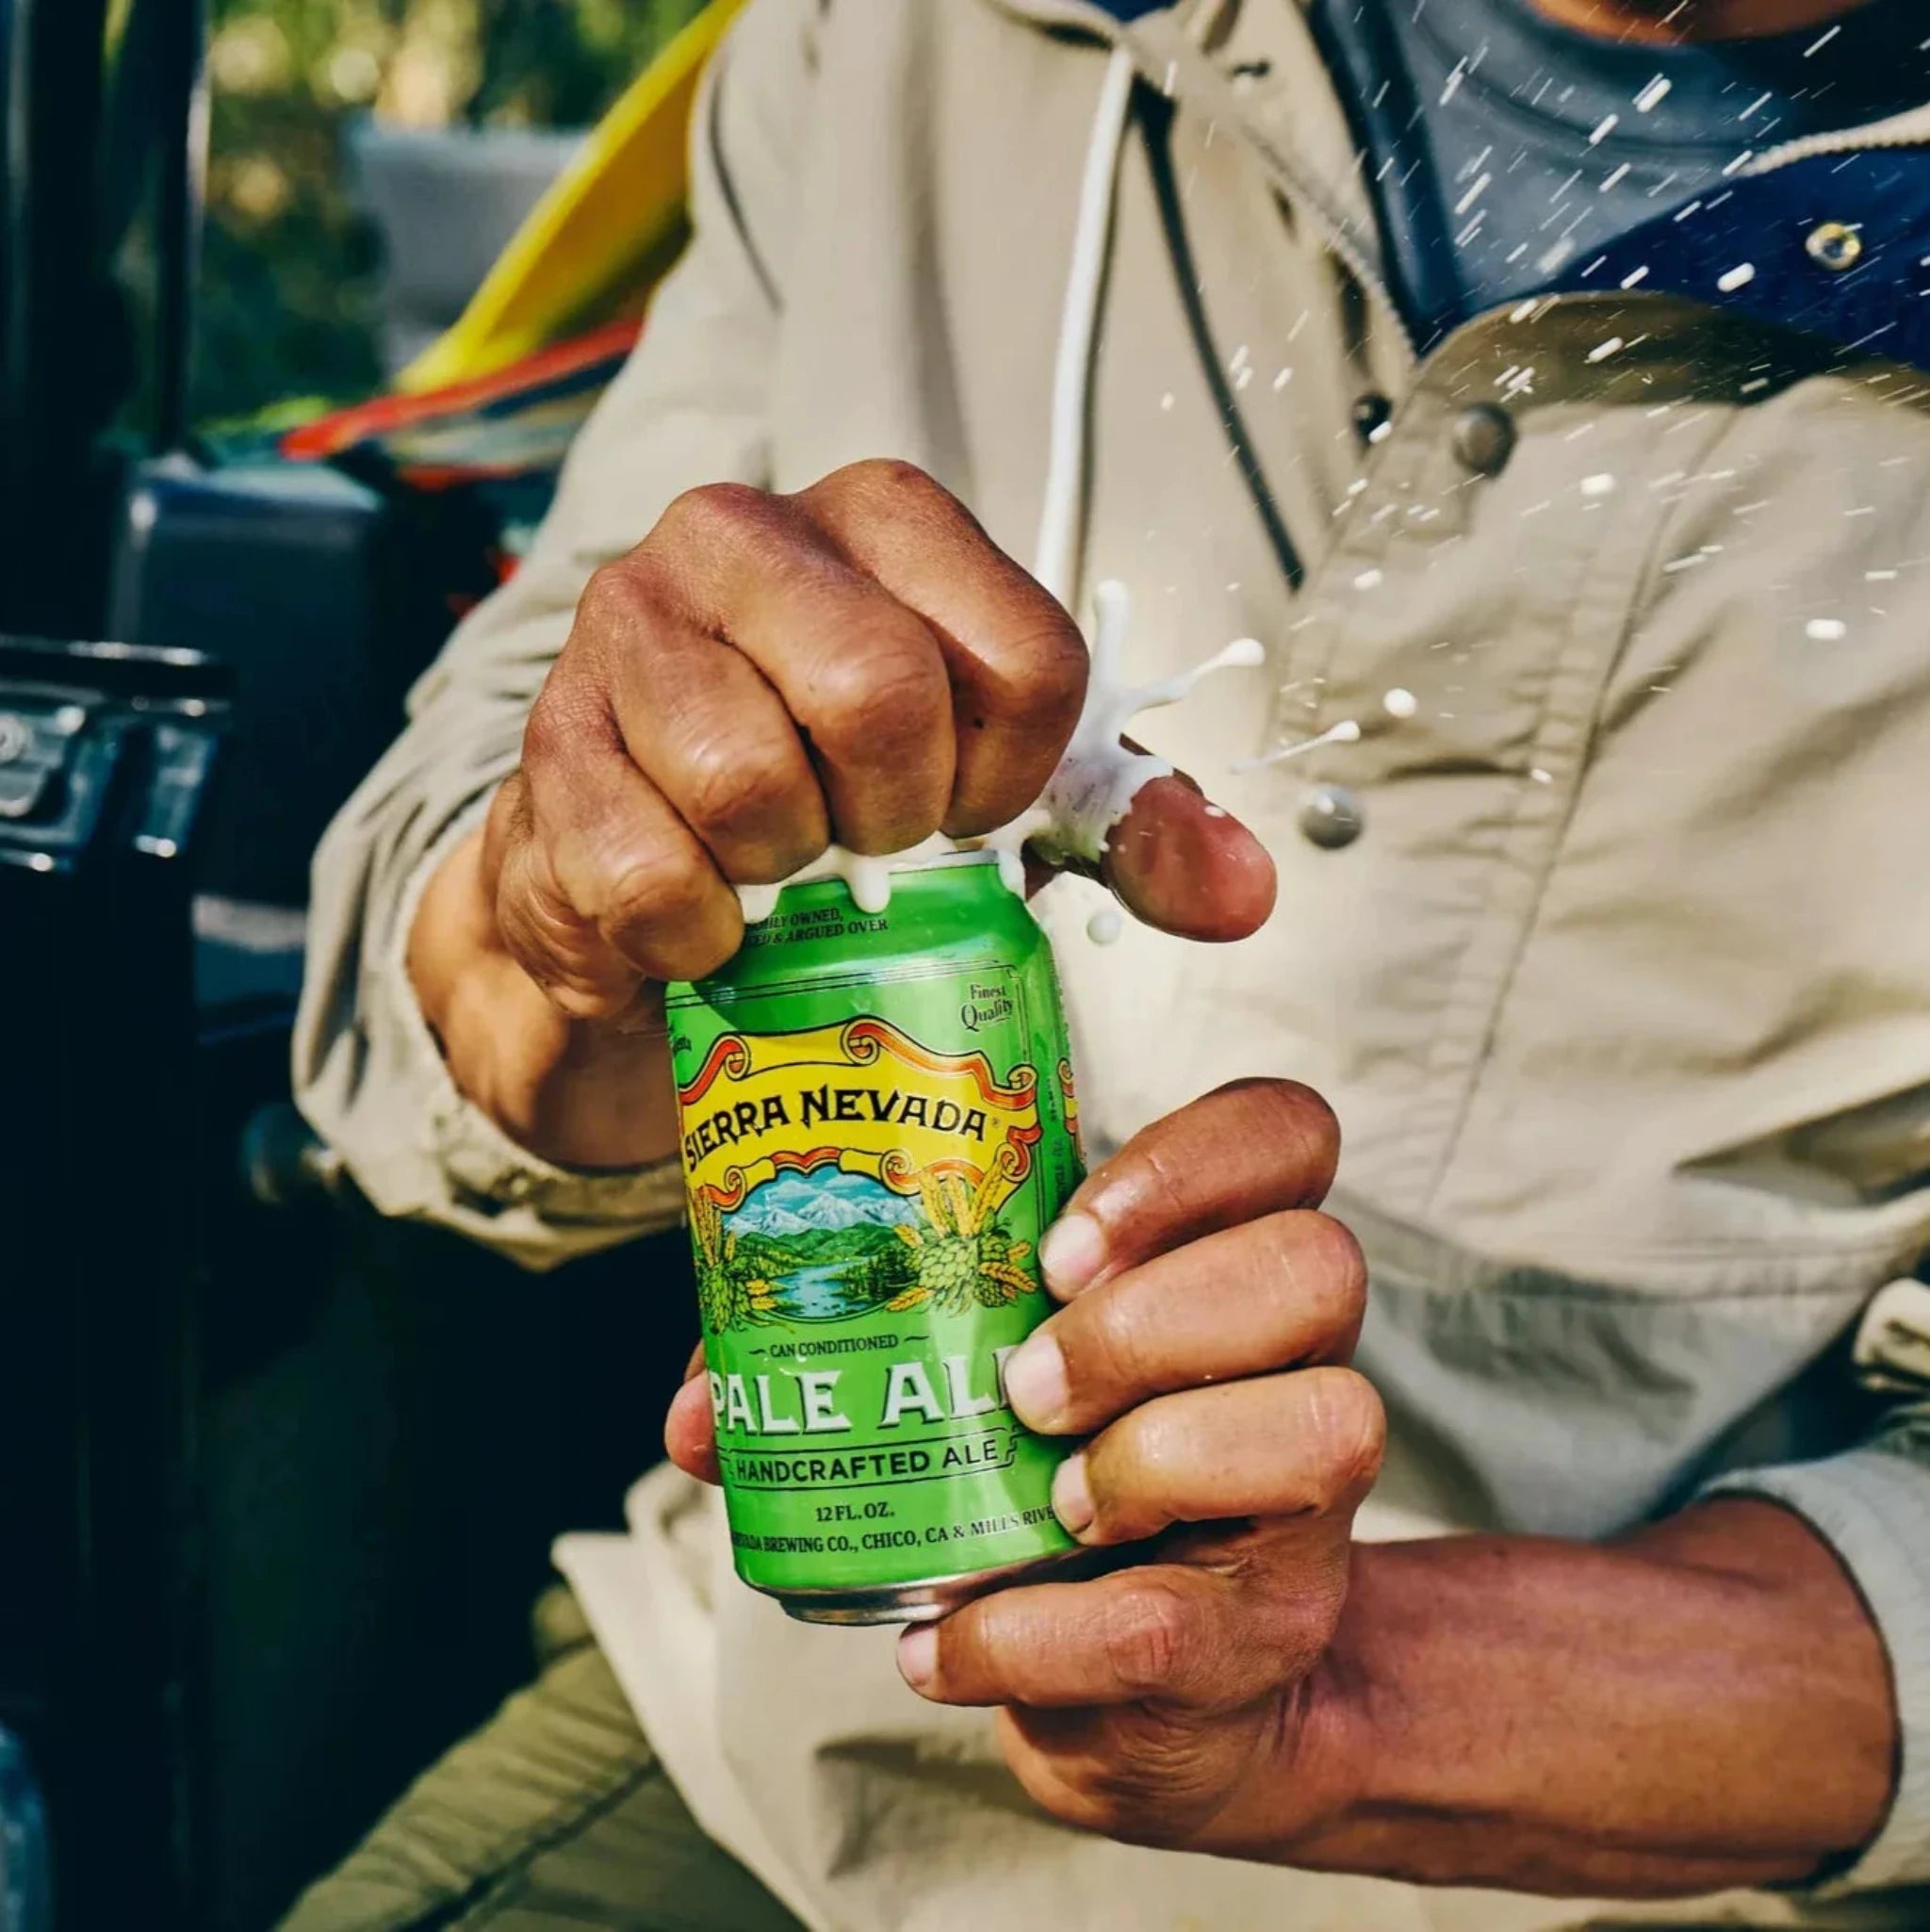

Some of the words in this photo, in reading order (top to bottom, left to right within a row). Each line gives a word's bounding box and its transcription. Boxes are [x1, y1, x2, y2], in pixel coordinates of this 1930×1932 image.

[786, 924, 845, 943] ARGUED
[849, 919, 889, 935] OVER
[790, 908, 844, 927] OWNED,
[970, 984, 1006, 1000] Finest
[960, 999, 1014, 1033] Quality
[684, 1094, 792, 1173] SIERRA
[799, 1083, 989, 1143] NEVADA
[770, 1343, 796, 1358] CAN
[799, 1334, 899, 1357] CONDITIONED
[709, 1368, 854, 1437] PALE
[736, 1449, 931, 1483] HANDCRAFTED
[941, 1438, 999, 1469] ALE
[863, 1501, 895, 1519] OZ.
[762, 1535, 824, 1553] BREWING
[826, 1535, 859, 1553] CO.,
[861, 1530, 922, 1550] CHICO,
[924, 1527, 949, 1544] CA
[952, 1525, 965, 1539] &
[1022, 1505, 1055, 1526] RIVE
